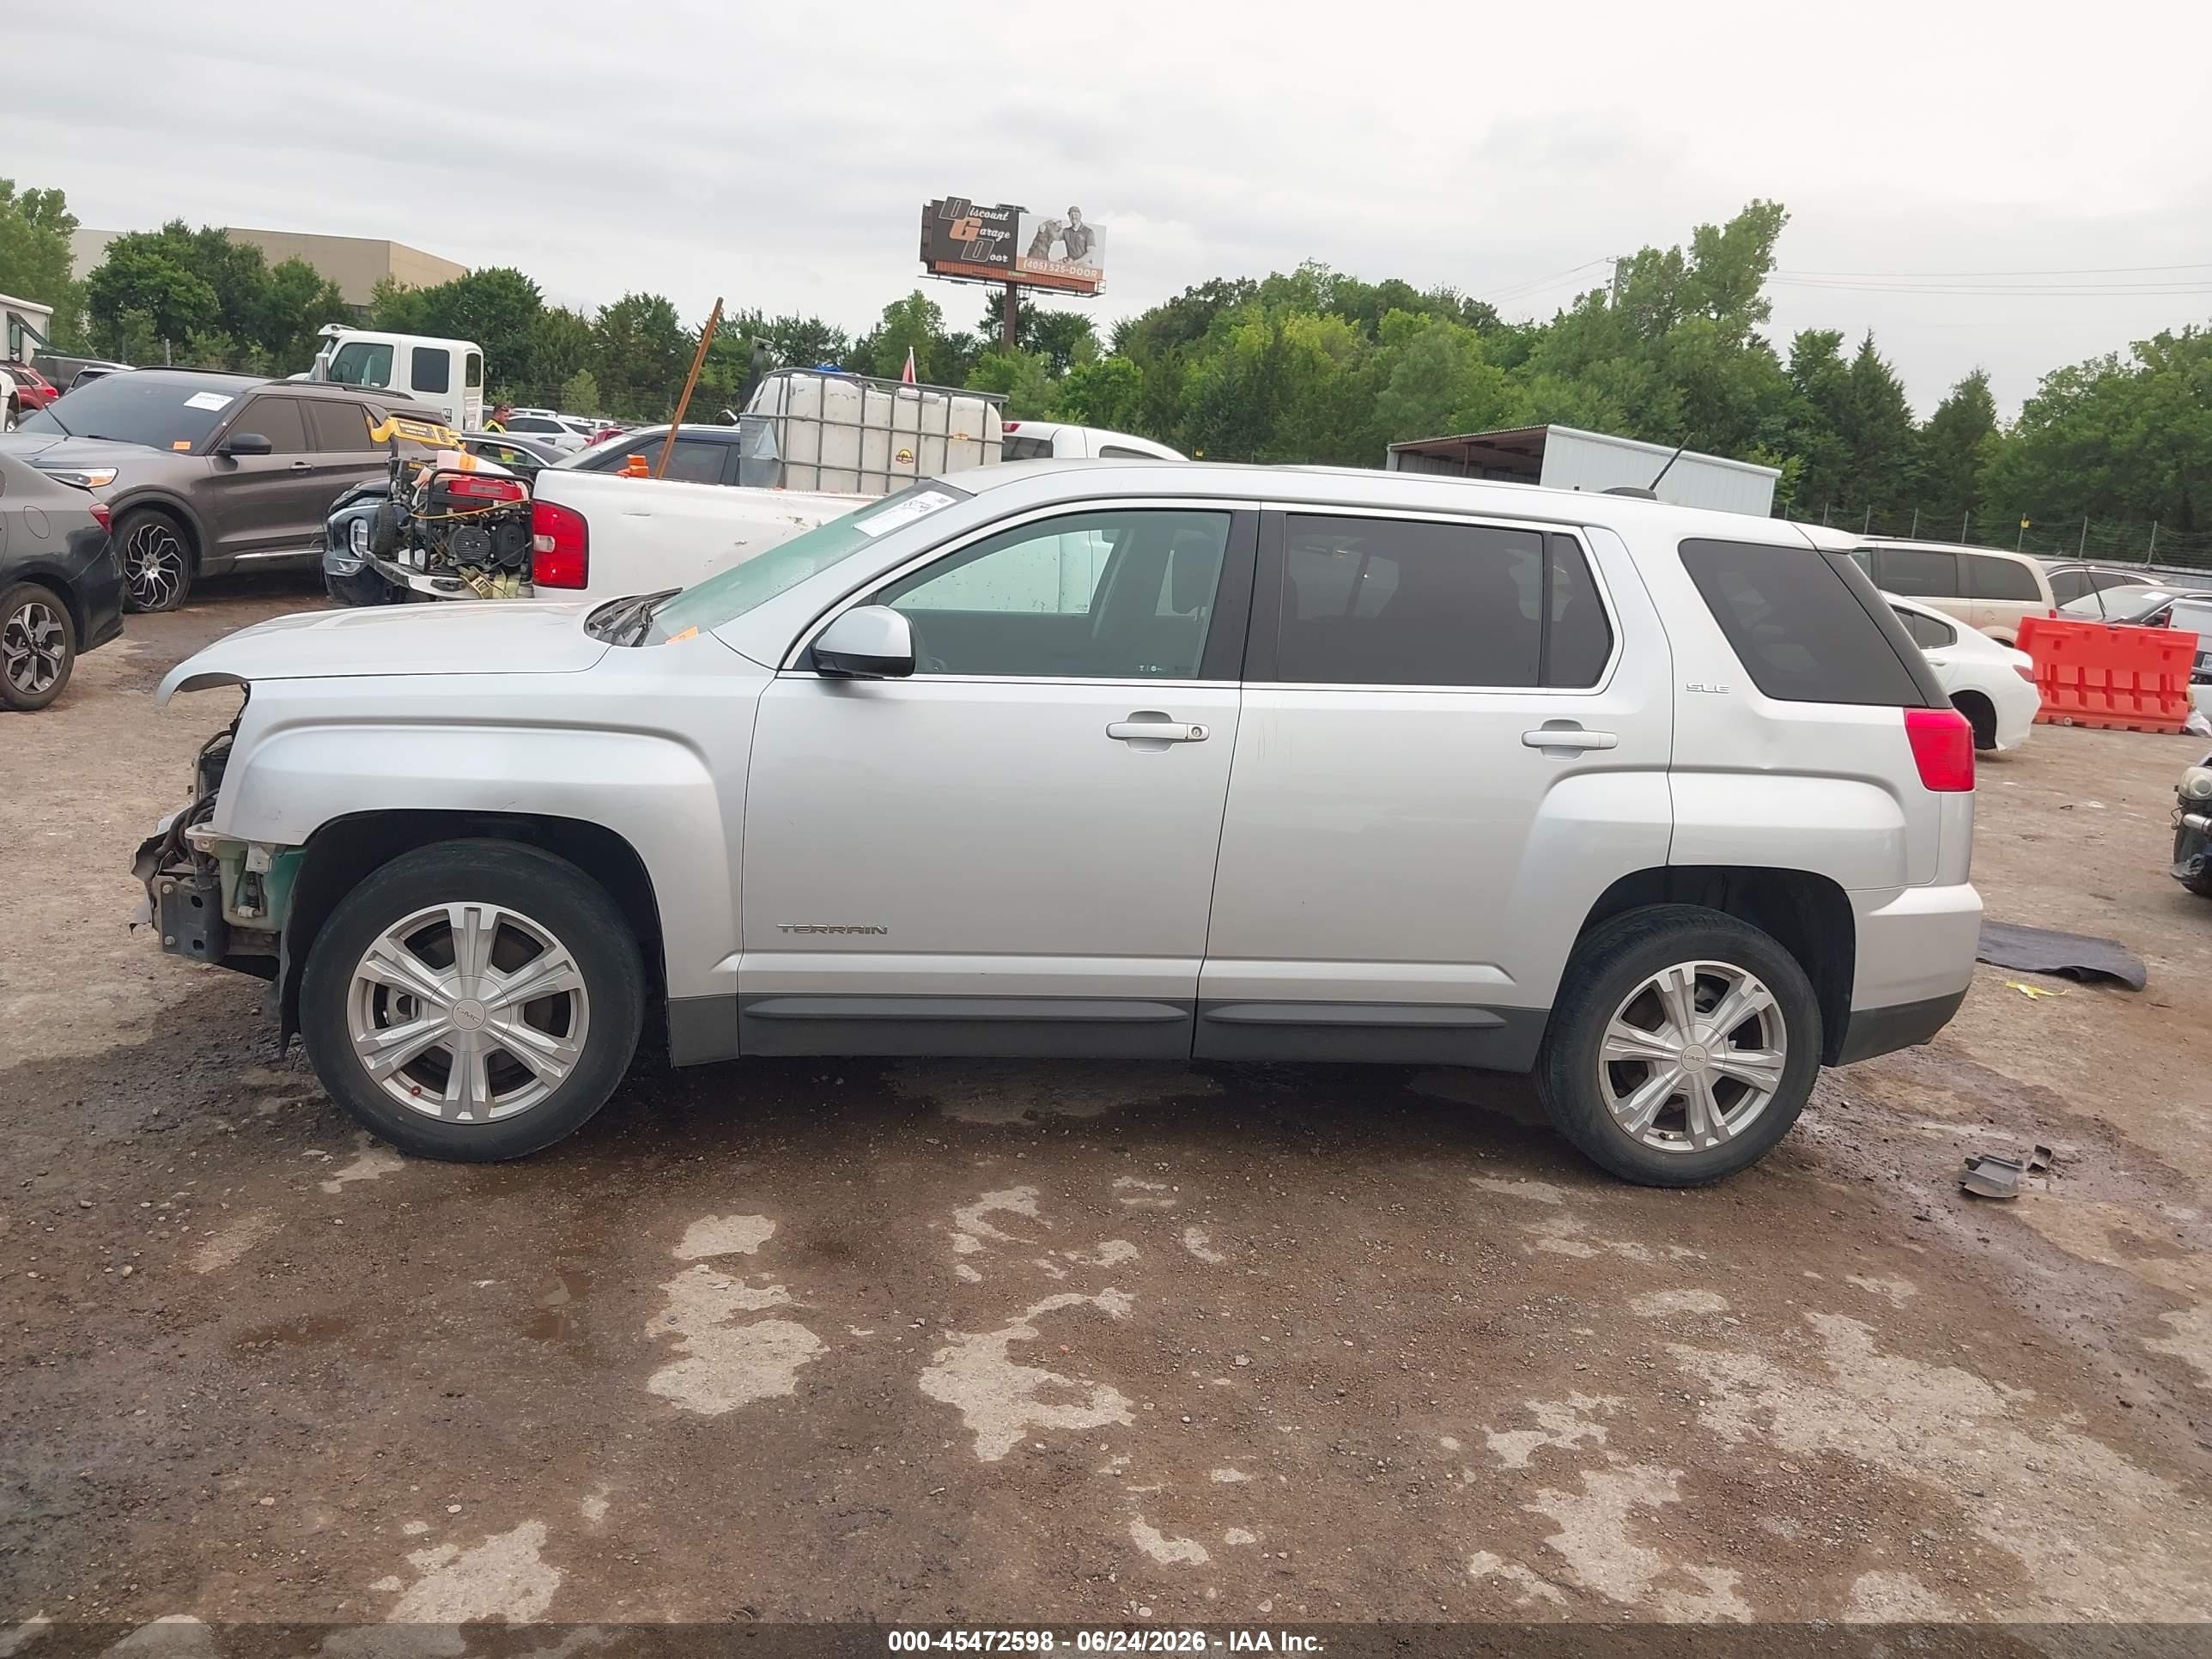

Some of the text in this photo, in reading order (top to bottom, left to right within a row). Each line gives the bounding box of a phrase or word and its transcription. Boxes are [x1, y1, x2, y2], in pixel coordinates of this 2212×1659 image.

[939, 197, 1009, 221] Discount
[949, 217, 1011, 242] Garage
[961, 238, 1009, 262] Door
[1024, 259, 1048, 271] (405)
[1686, 682, 1730, 694] SLE
[777, 924, 888, 934] TERRAIN
[457, 1006, 482, 1024] GMC
